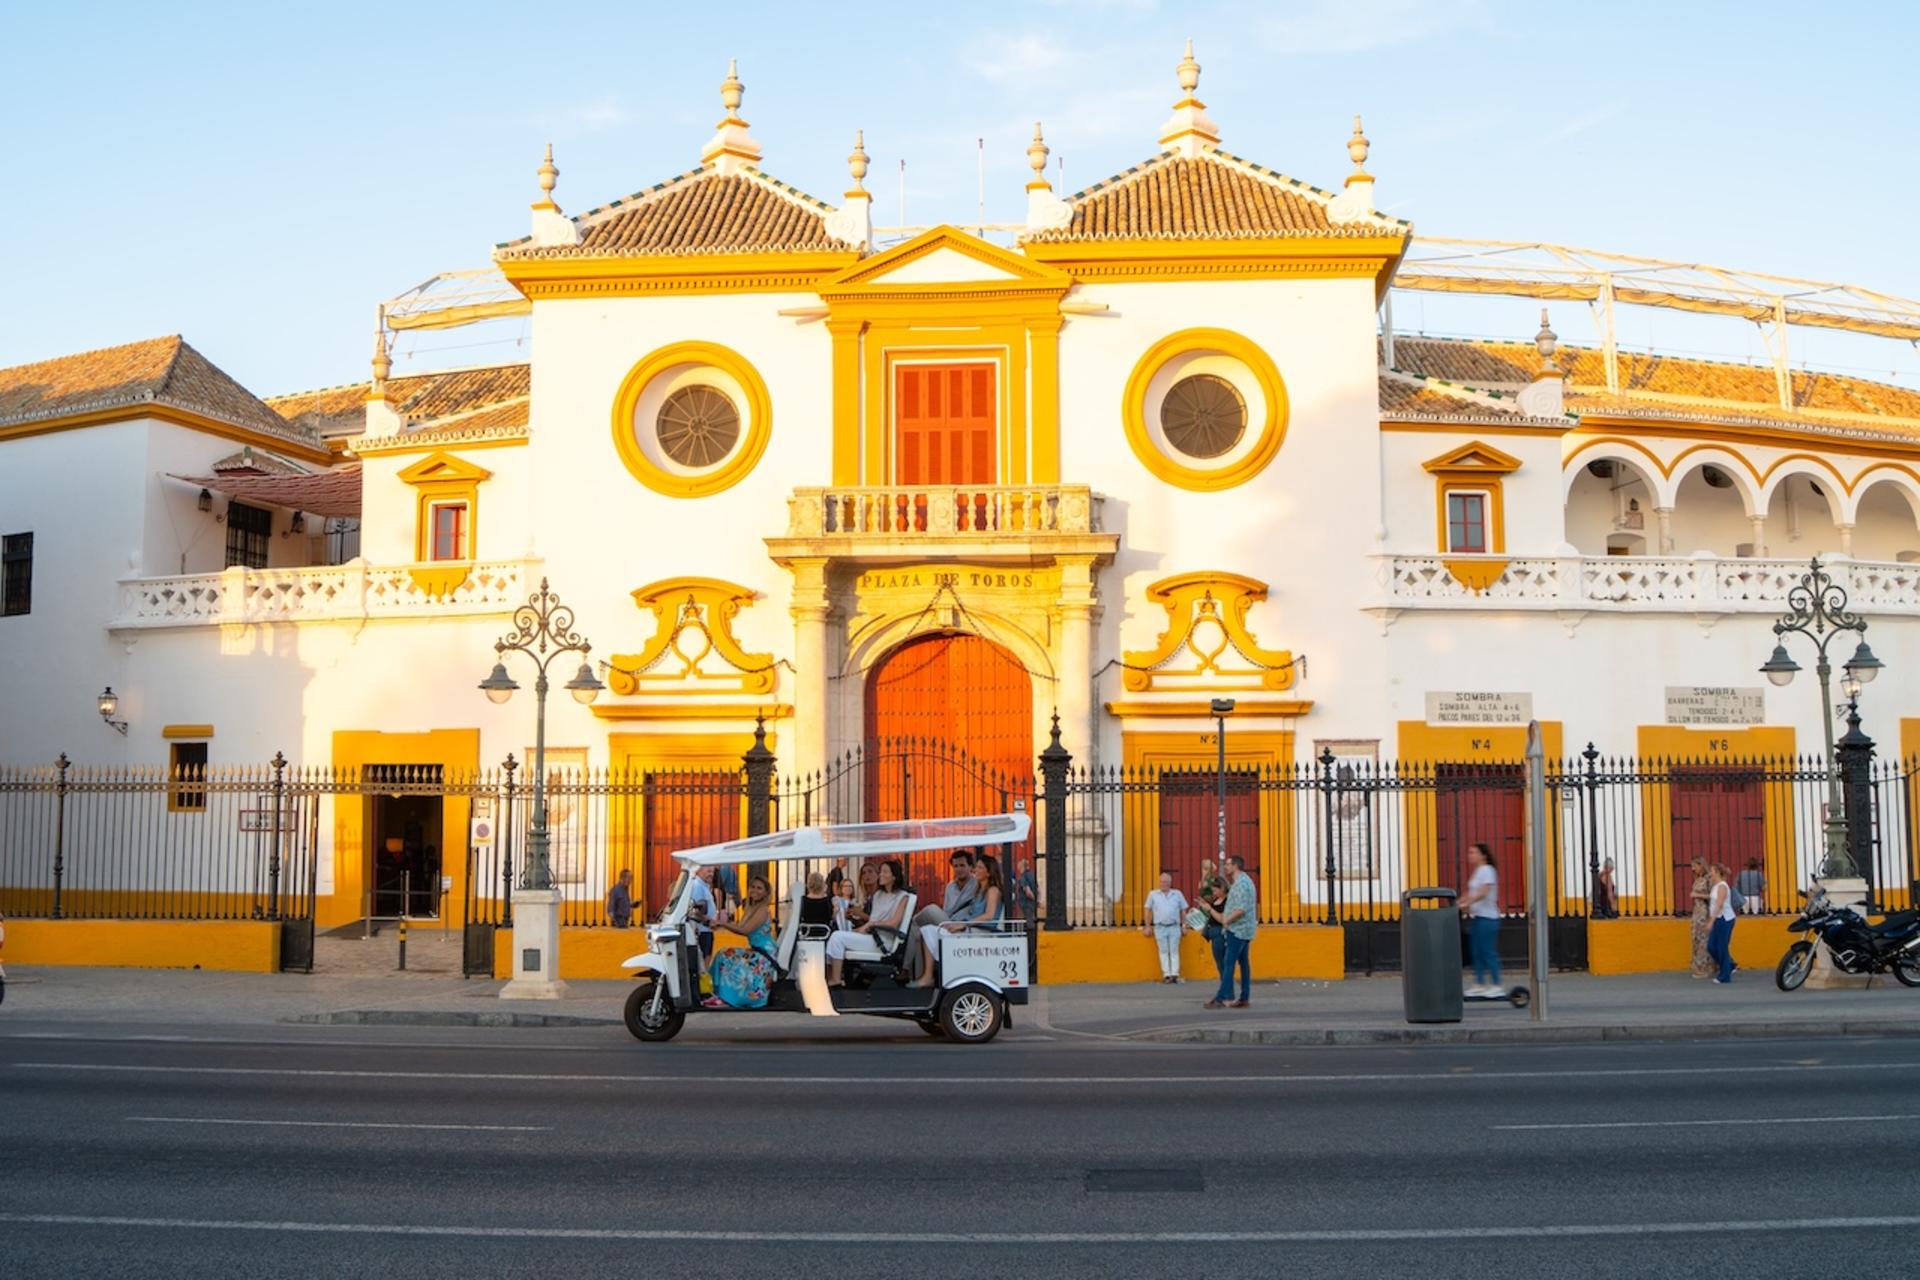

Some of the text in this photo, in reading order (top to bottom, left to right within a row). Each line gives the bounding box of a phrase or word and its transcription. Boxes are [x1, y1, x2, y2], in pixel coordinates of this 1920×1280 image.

[862, 572, 1033, 588] PLAZA DE TOROS
[1455, 692, 1502, 701] SOMBRA
[1693, 687, 1736, 696] SOMBRA
[1439, 703, 1470, 711] SOMBRA
[1478, 703, 1498, 711] ALTA
[1483, 739, 1491, 750] 4
[1721, 739, 1729, 751] 6
[999, 960, 1018, 979] 33
